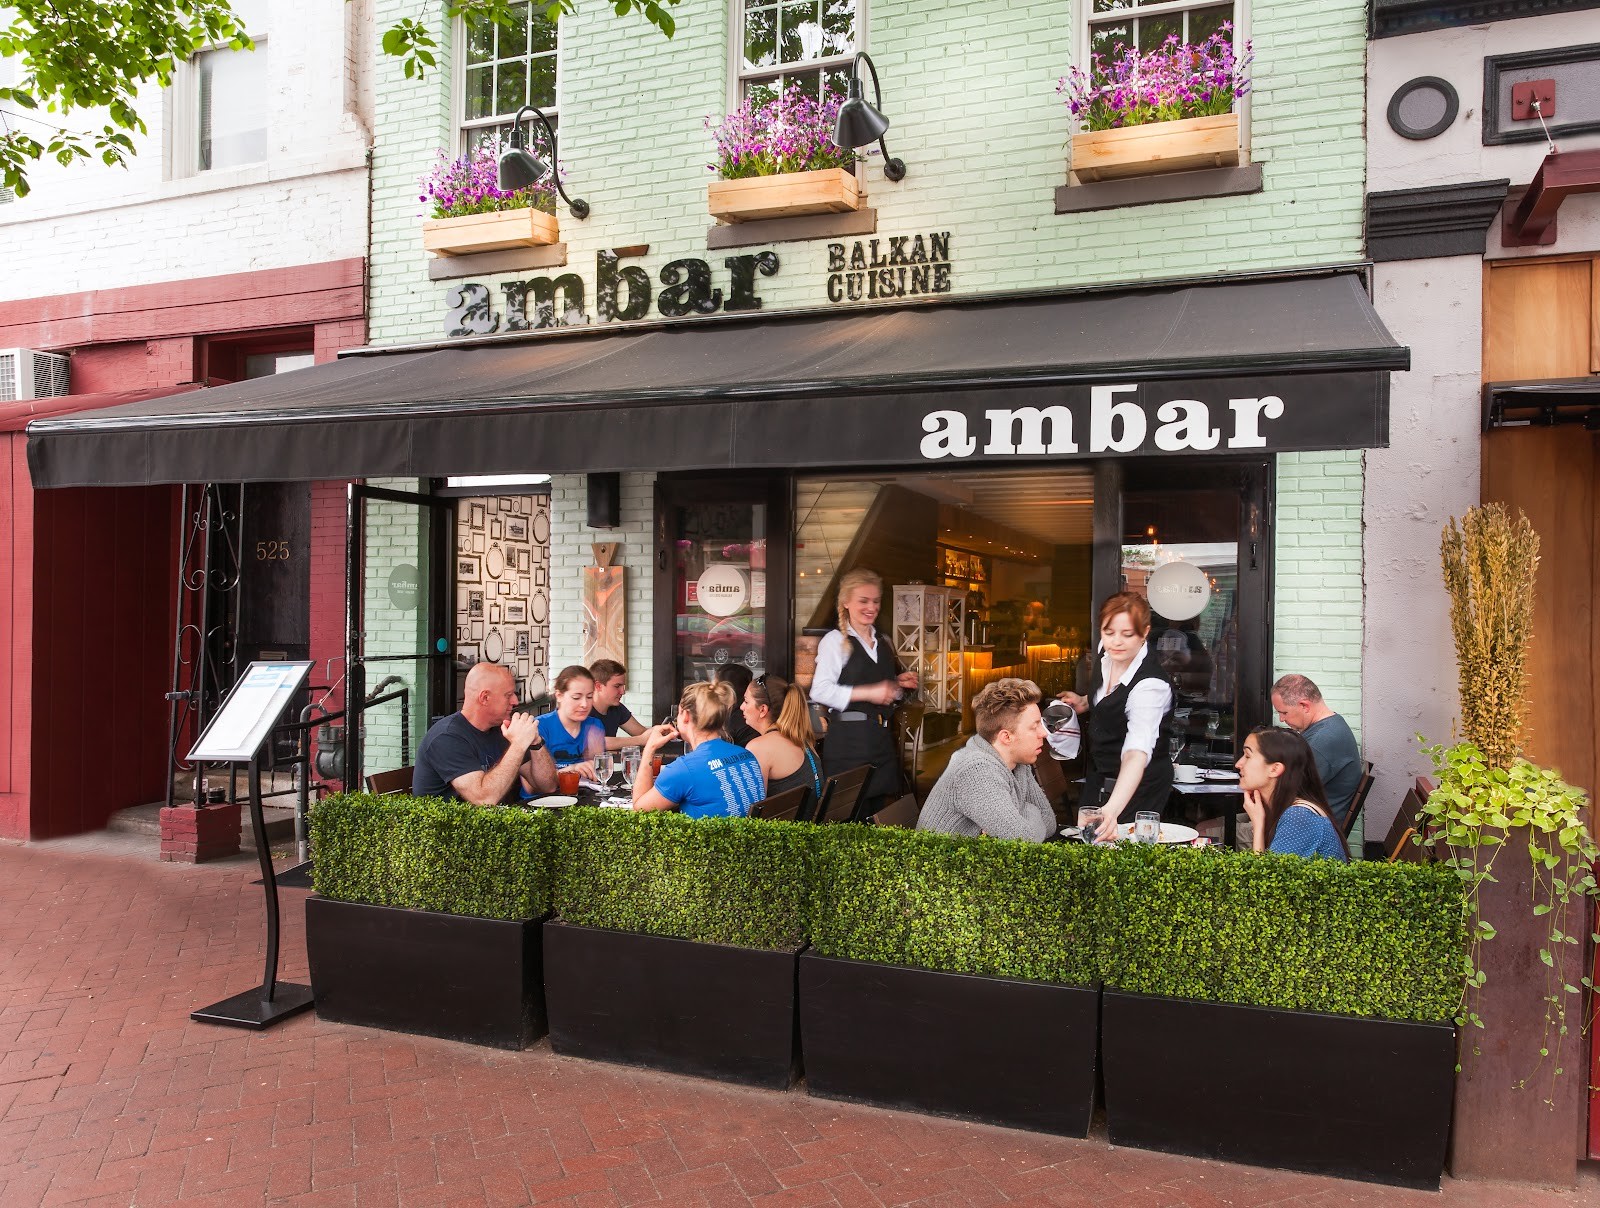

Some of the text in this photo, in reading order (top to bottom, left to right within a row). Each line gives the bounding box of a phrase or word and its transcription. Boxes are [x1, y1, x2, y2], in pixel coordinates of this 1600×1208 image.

[828, 232, 950, 272] BALKAN
[445, 245, 779, 338] ambar
[828, 263, 951, 302] CUISINE
[920, 384, 1285, 459] ambar
[256, 541, 290, 560] 525
[708, 758, 723, 771] 2014
